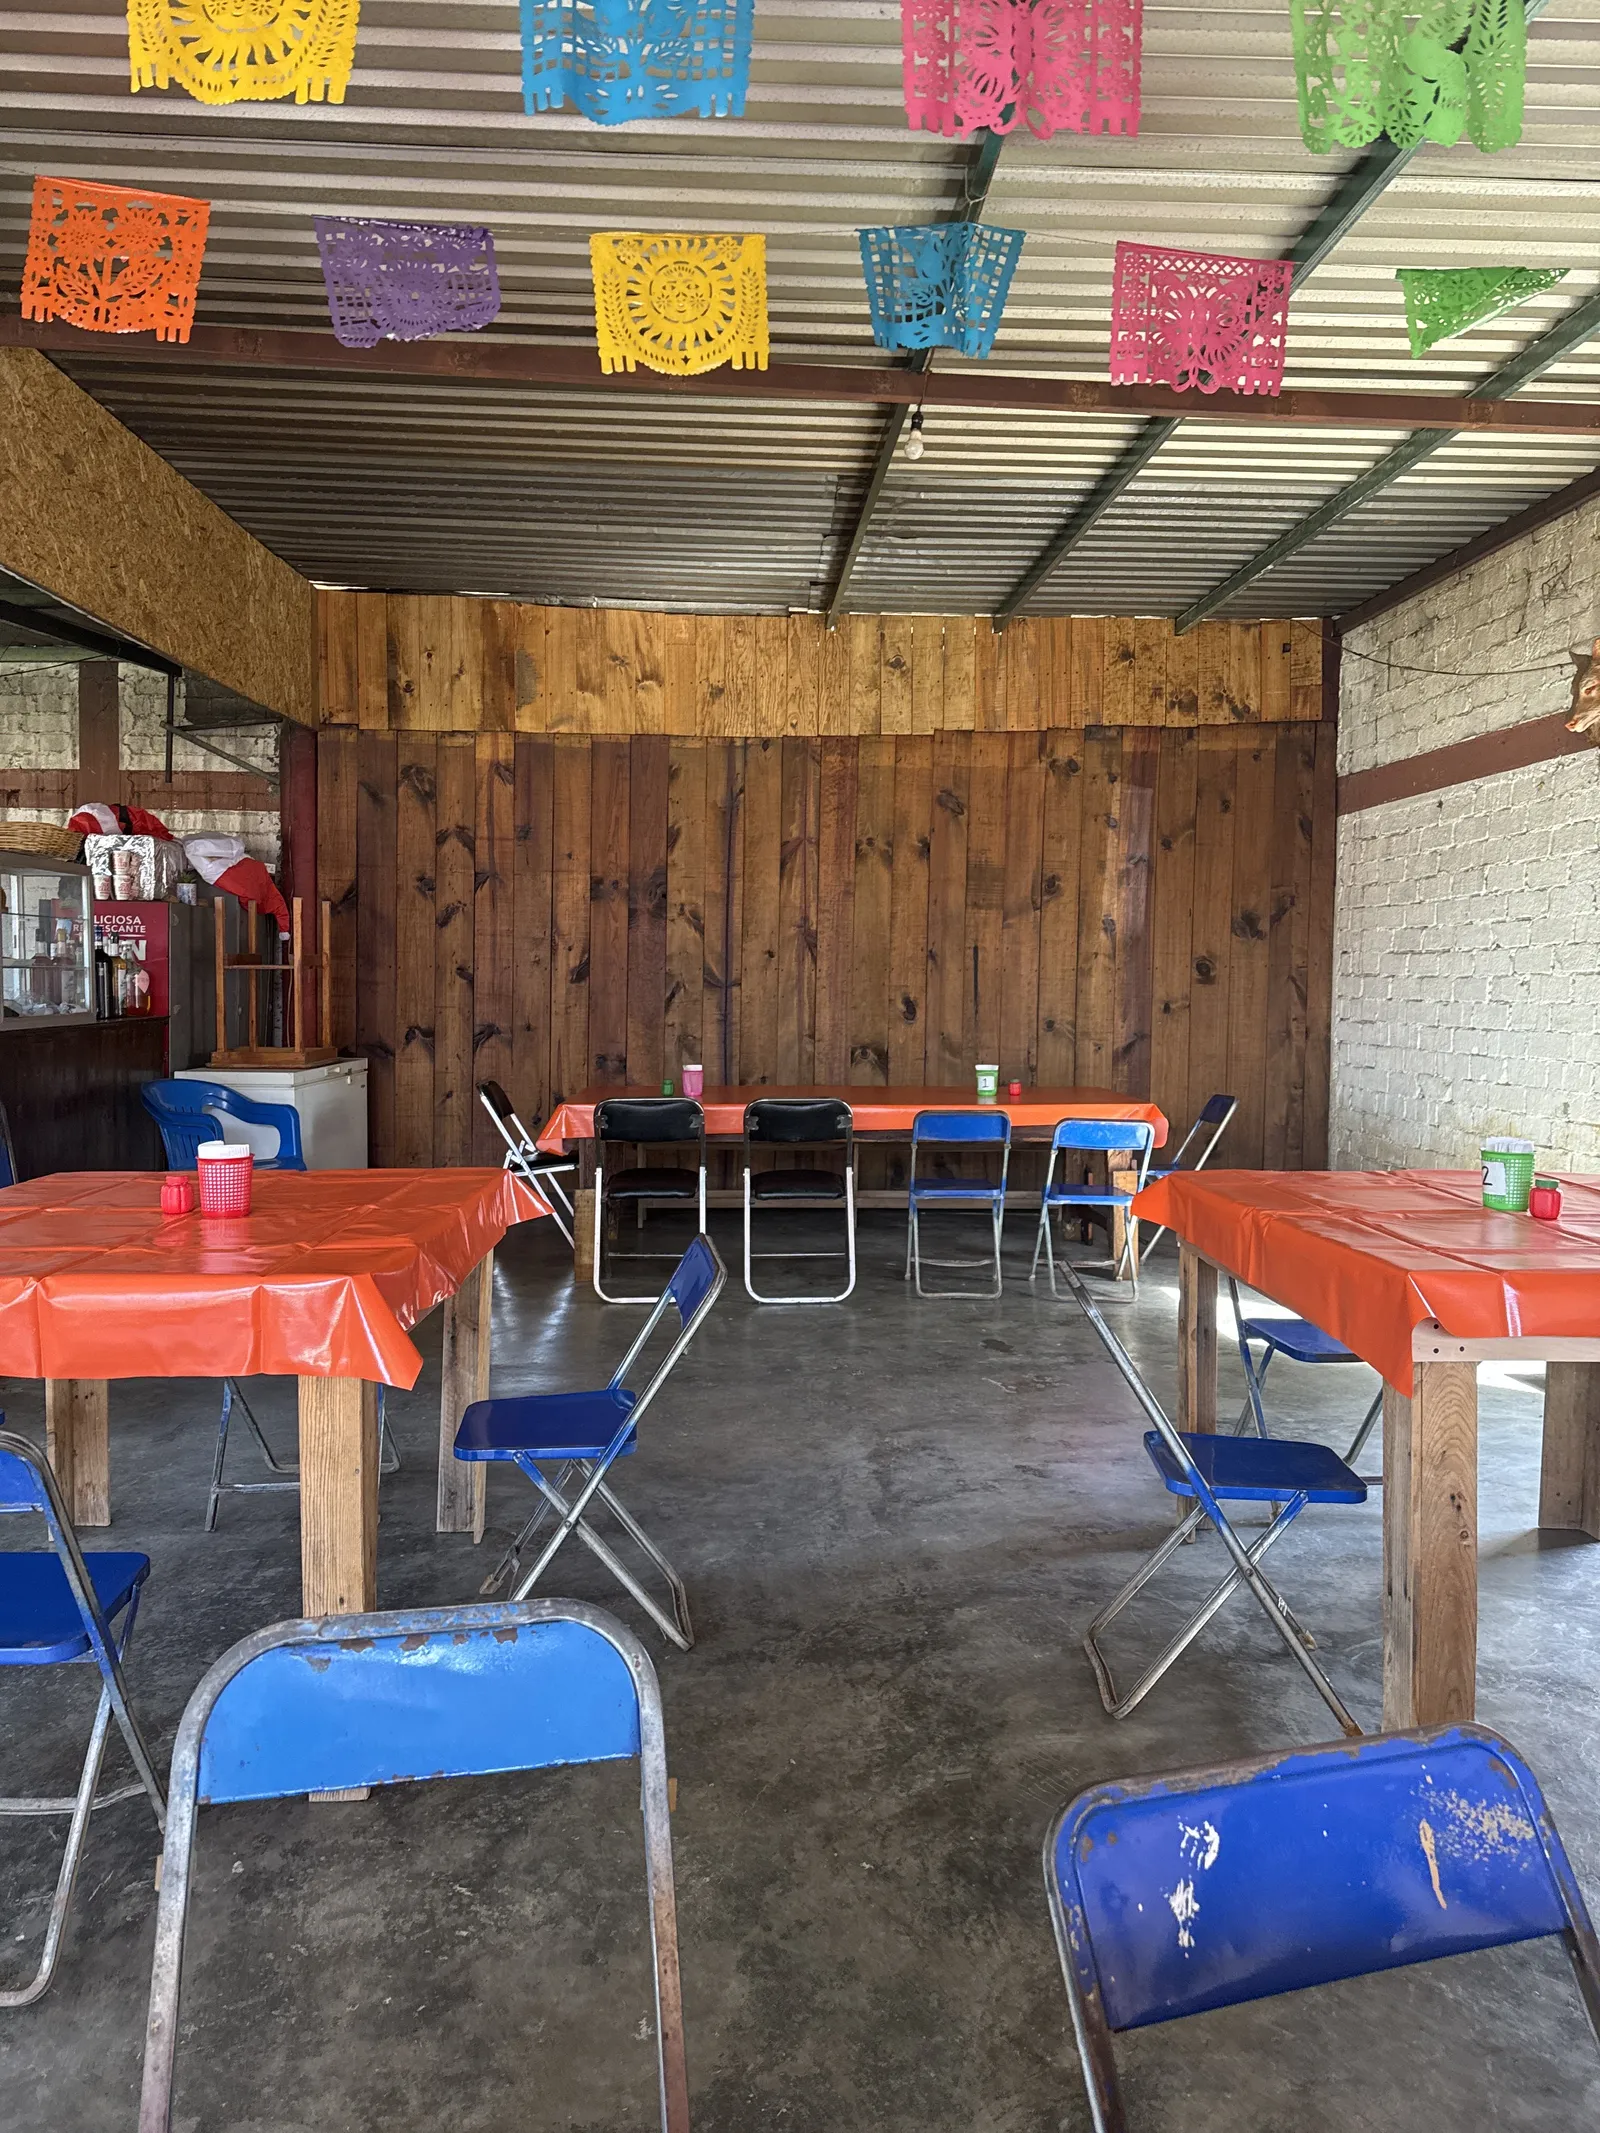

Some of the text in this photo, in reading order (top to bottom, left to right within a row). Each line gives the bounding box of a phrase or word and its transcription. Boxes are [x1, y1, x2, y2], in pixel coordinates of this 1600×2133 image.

[78, 915, 141, 925] LICIOSA
[982, 1078, 990, 1089] 1
[1481, 1165, 1493, 1186] 2
